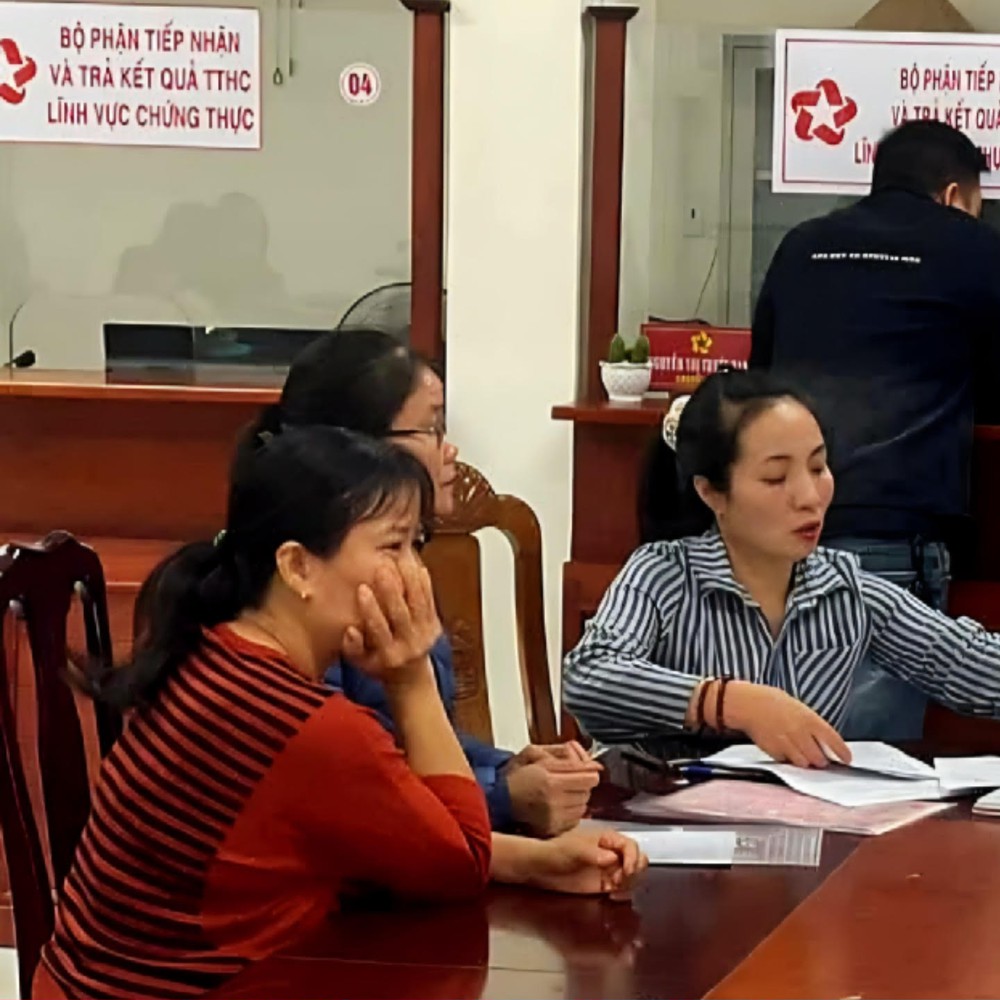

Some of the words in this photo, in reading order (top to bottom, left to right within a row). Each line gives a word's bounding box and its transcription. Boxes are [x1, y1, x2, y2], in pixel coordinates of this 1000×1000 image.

[60, 22, 85, 53] BỘ
[90, 23, 139, 54] PHẬN
[144, 20, 184, 52] TIẾP
[190, 26, 240, 57] NHẬN
[49, 58, 74, 86] VÀ
[78, 57, 115, 88] TRẢ
[120, 57, 155, 90] KẾT
[160, 59, 199, 91] QUẢ
[202, 69, 251, 93] TTHC
[348, 73, 372, 96] 04
[900, 62, 920, 95] BỘ
[923, 63, 961, 96] PHẬN
[965, 60, 995, 92] TIẾP
[47, 96, 88, 125] LĨNH
[93, 102, 130, 131] VỰC
[135, 99, 200, 129] CHỨNG
[205, 105, 254, 134] THỰC
[945, 98, 971, 129] KẾT
